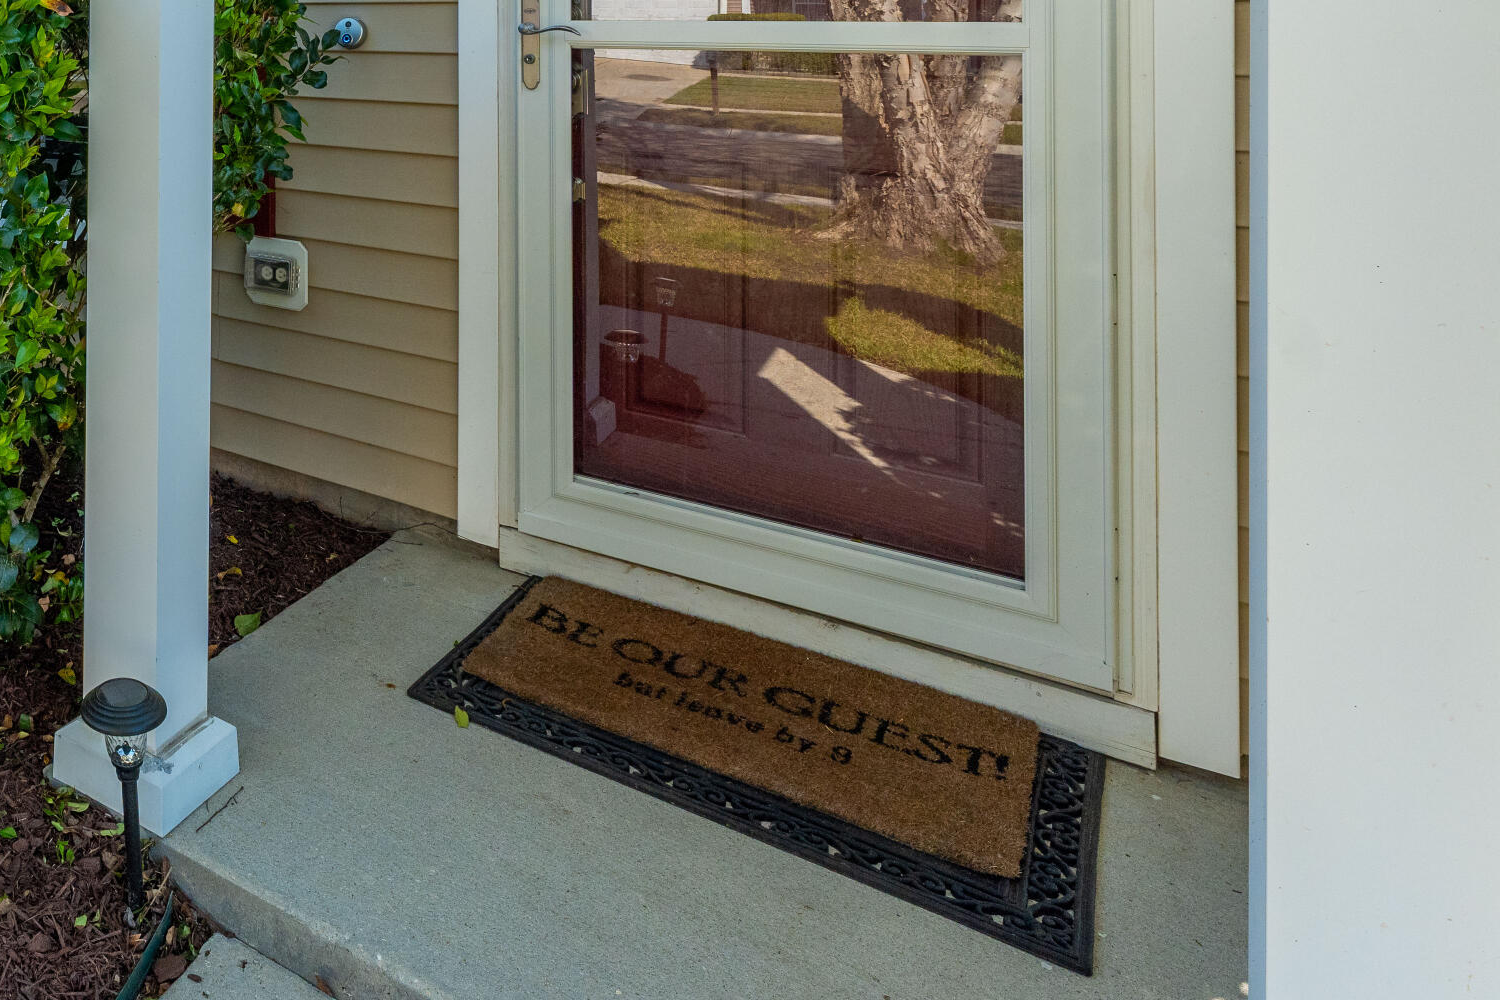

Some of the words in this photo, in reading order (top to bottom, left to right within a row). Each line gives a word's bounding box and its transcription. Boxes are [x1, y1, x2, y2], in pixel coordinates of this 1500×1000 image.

[526, 603, 604, 648] BE
[611, 638, 748, 698] OUR
[764, 686, 1010, 781] GUEST!
[613, 672, 667, 700] but
[674, 691, 765, 733] leave
[776, 722, 817, 753] by
